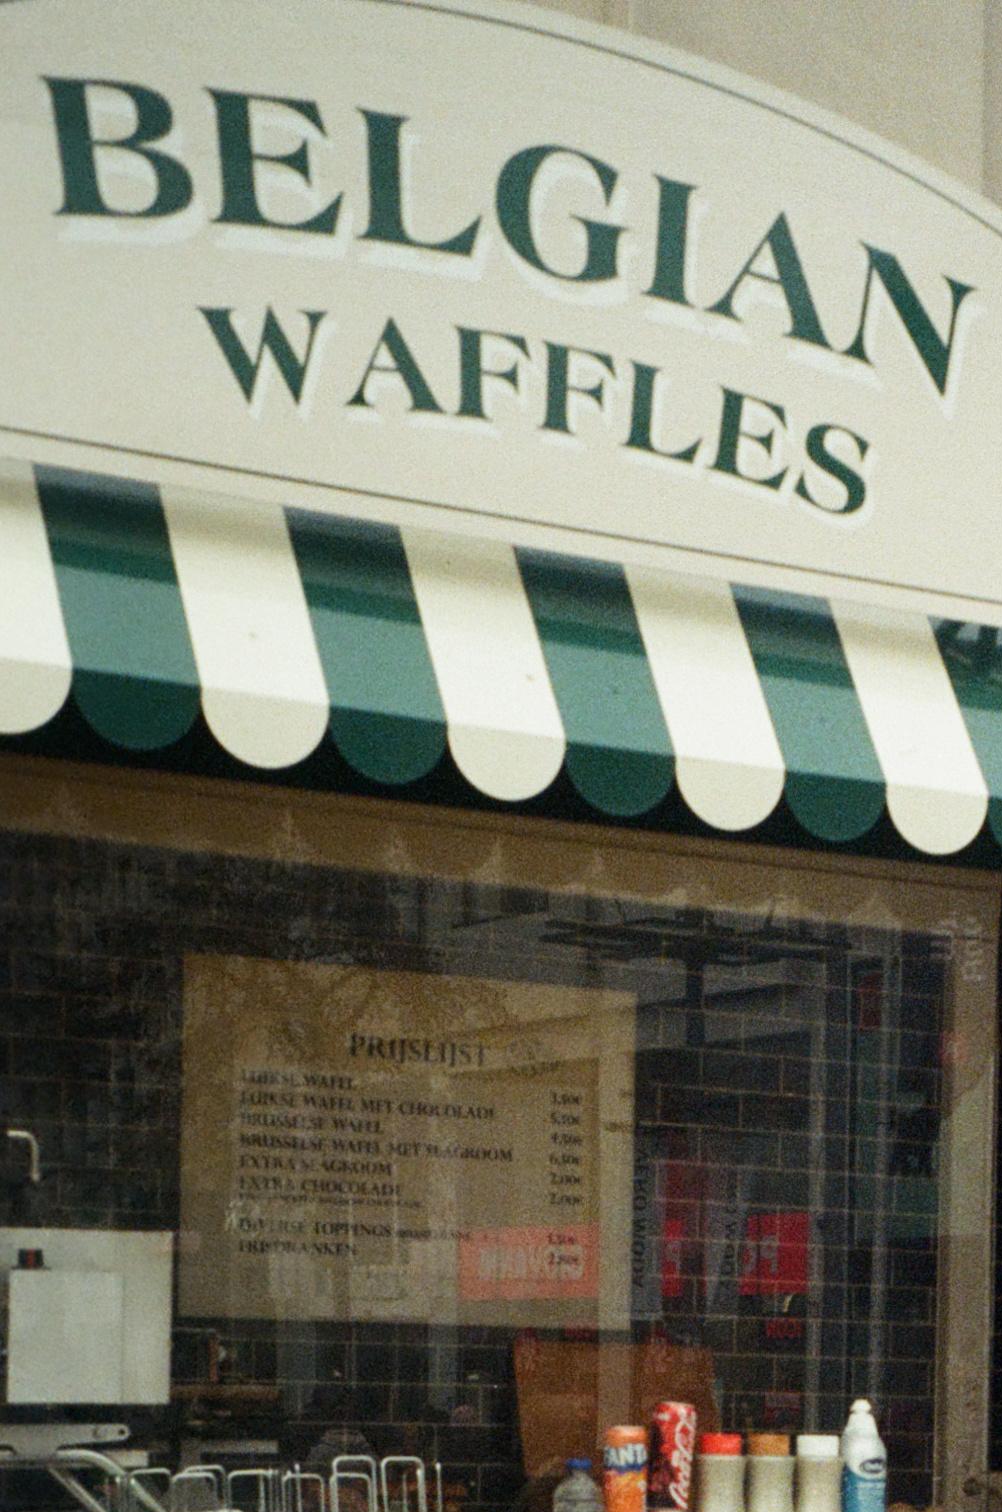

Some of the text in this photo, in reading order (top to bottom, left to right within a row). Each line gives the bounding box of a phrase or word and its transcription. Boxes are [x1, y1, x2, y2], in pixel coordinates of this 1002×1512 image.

[39, 74, 978, 398] BELGIAN
[195, 303, 872, 517] WAFFLES
[350, 1034, 488, 1067] PRIJSLIJST
